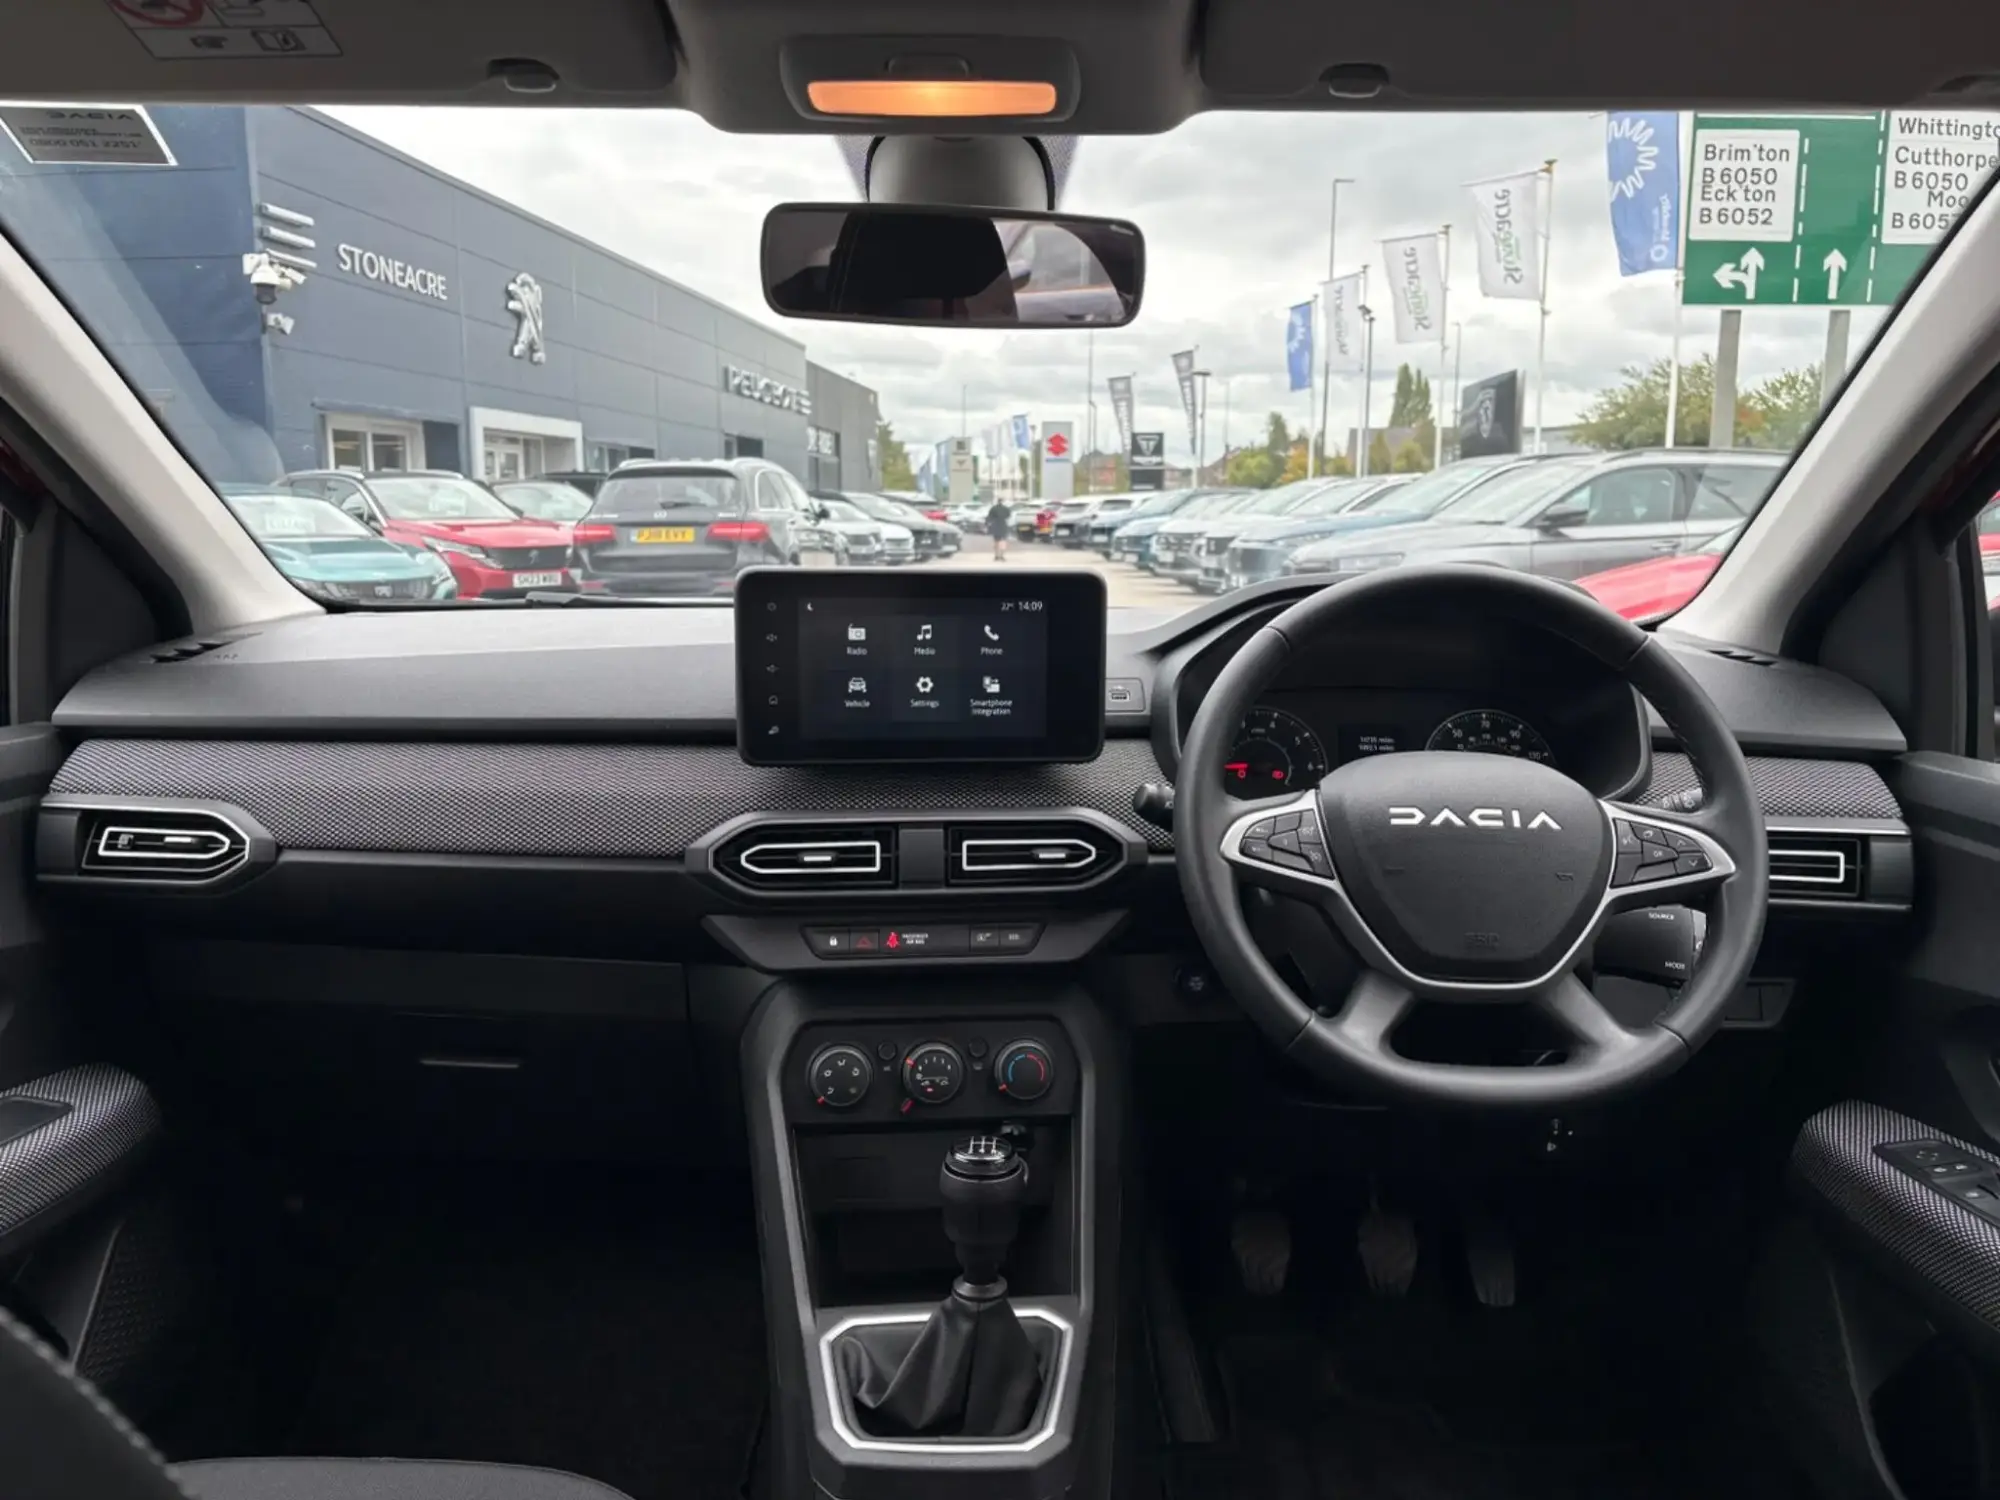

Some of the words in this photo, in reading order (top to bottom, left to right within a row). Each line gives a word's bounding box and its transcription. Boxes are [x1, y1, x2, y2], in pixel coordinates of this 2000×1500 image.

[1895, 145, 2000, 171] Cutthorpe
[338, 243, 448, 300] STONEACRE
[1018, 601, 1043, 611] 14:09
[846, 647, 868, 655] Radio
[914, 647, 936, 655] Media
[980, 647, 1003, 655] Phone
[844, 700, 871, 708] Vehicle
[910, 699, 940, 708] Settings
[969, 699, 1013, 709] Smartphone
[1388, 806, 1563, 831] DACIA
[1648, 912, 1675, 921] SOURCE
[1664, 960, 1686, 970] MODE
